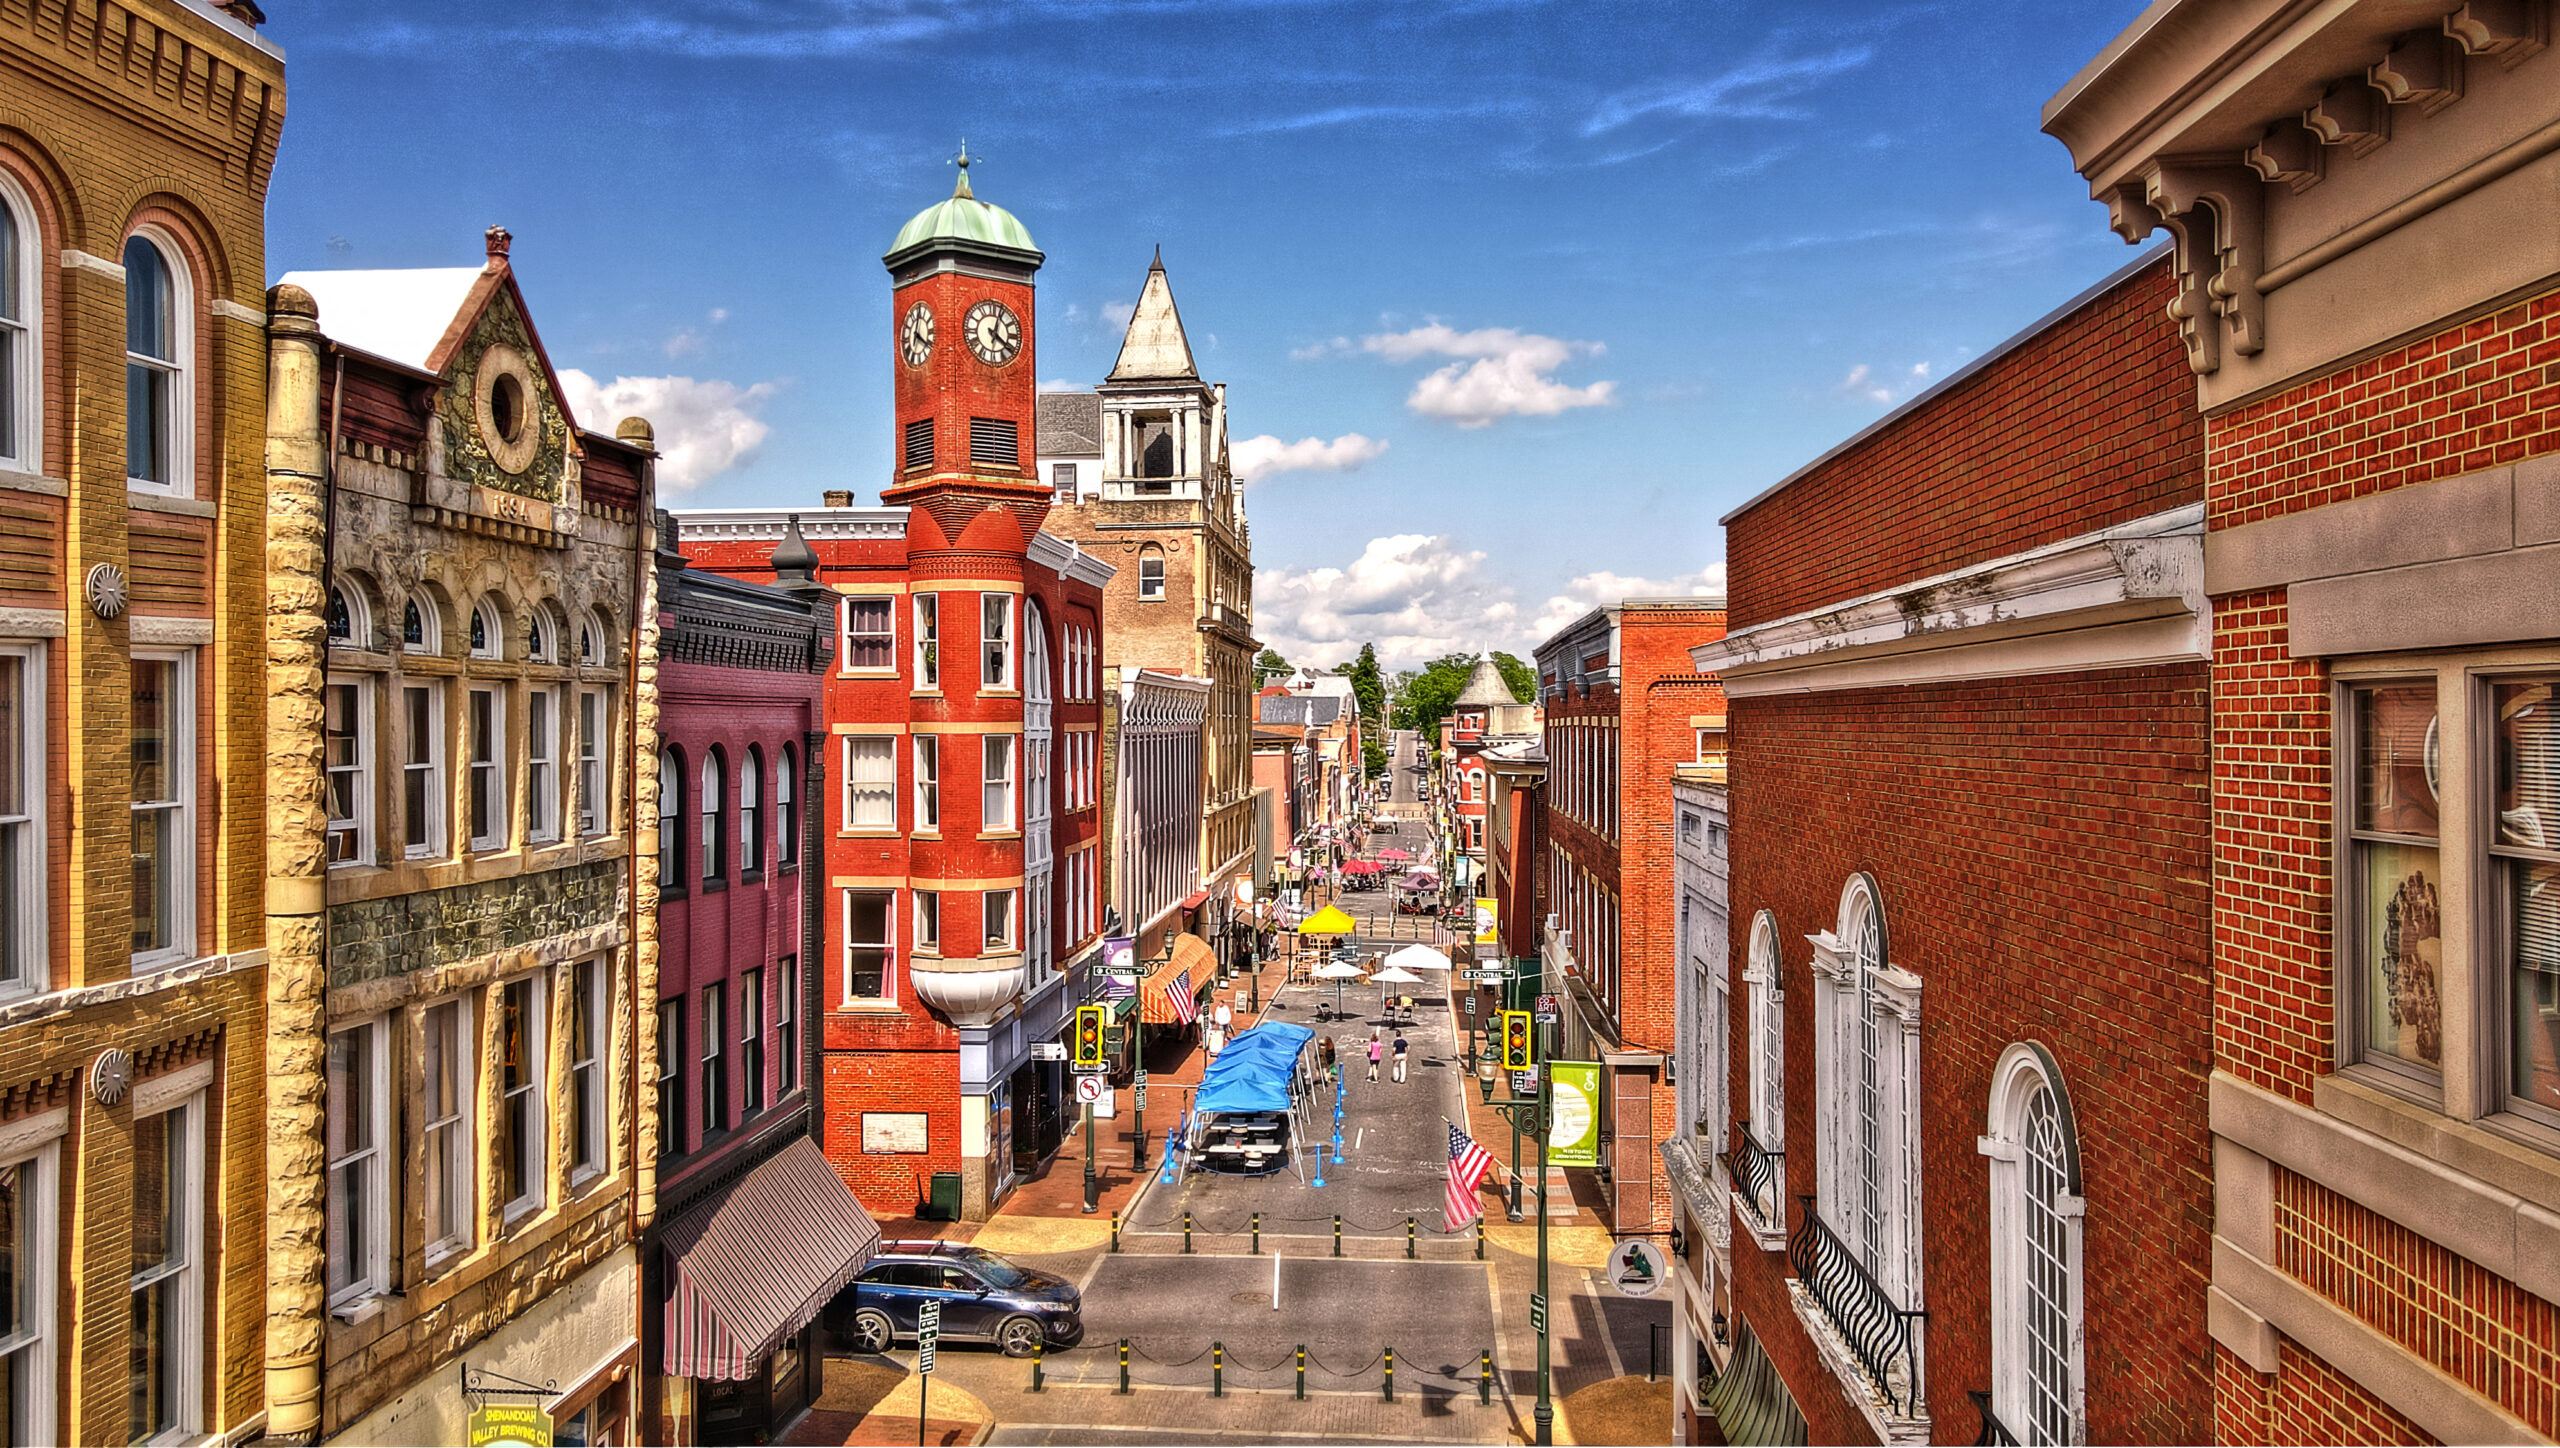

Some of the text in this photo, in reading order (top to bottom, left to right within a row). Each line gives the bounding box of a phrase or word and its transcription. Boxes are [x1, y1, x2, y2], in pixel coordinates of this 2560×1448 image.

[1105, 968, 1134, 976] CENTRAL
[1473, 970, 1503, 979] CENTRAL
[1538, 1003, 1555, 1012] ART
[713, 1386, 734, 1397] LOCAL
[485, 1410, 537, 1424] SHENANDOAH
[472, 1424, 500, 1446] VALLEY
[500, 1425, 536, 1442] BREWING
